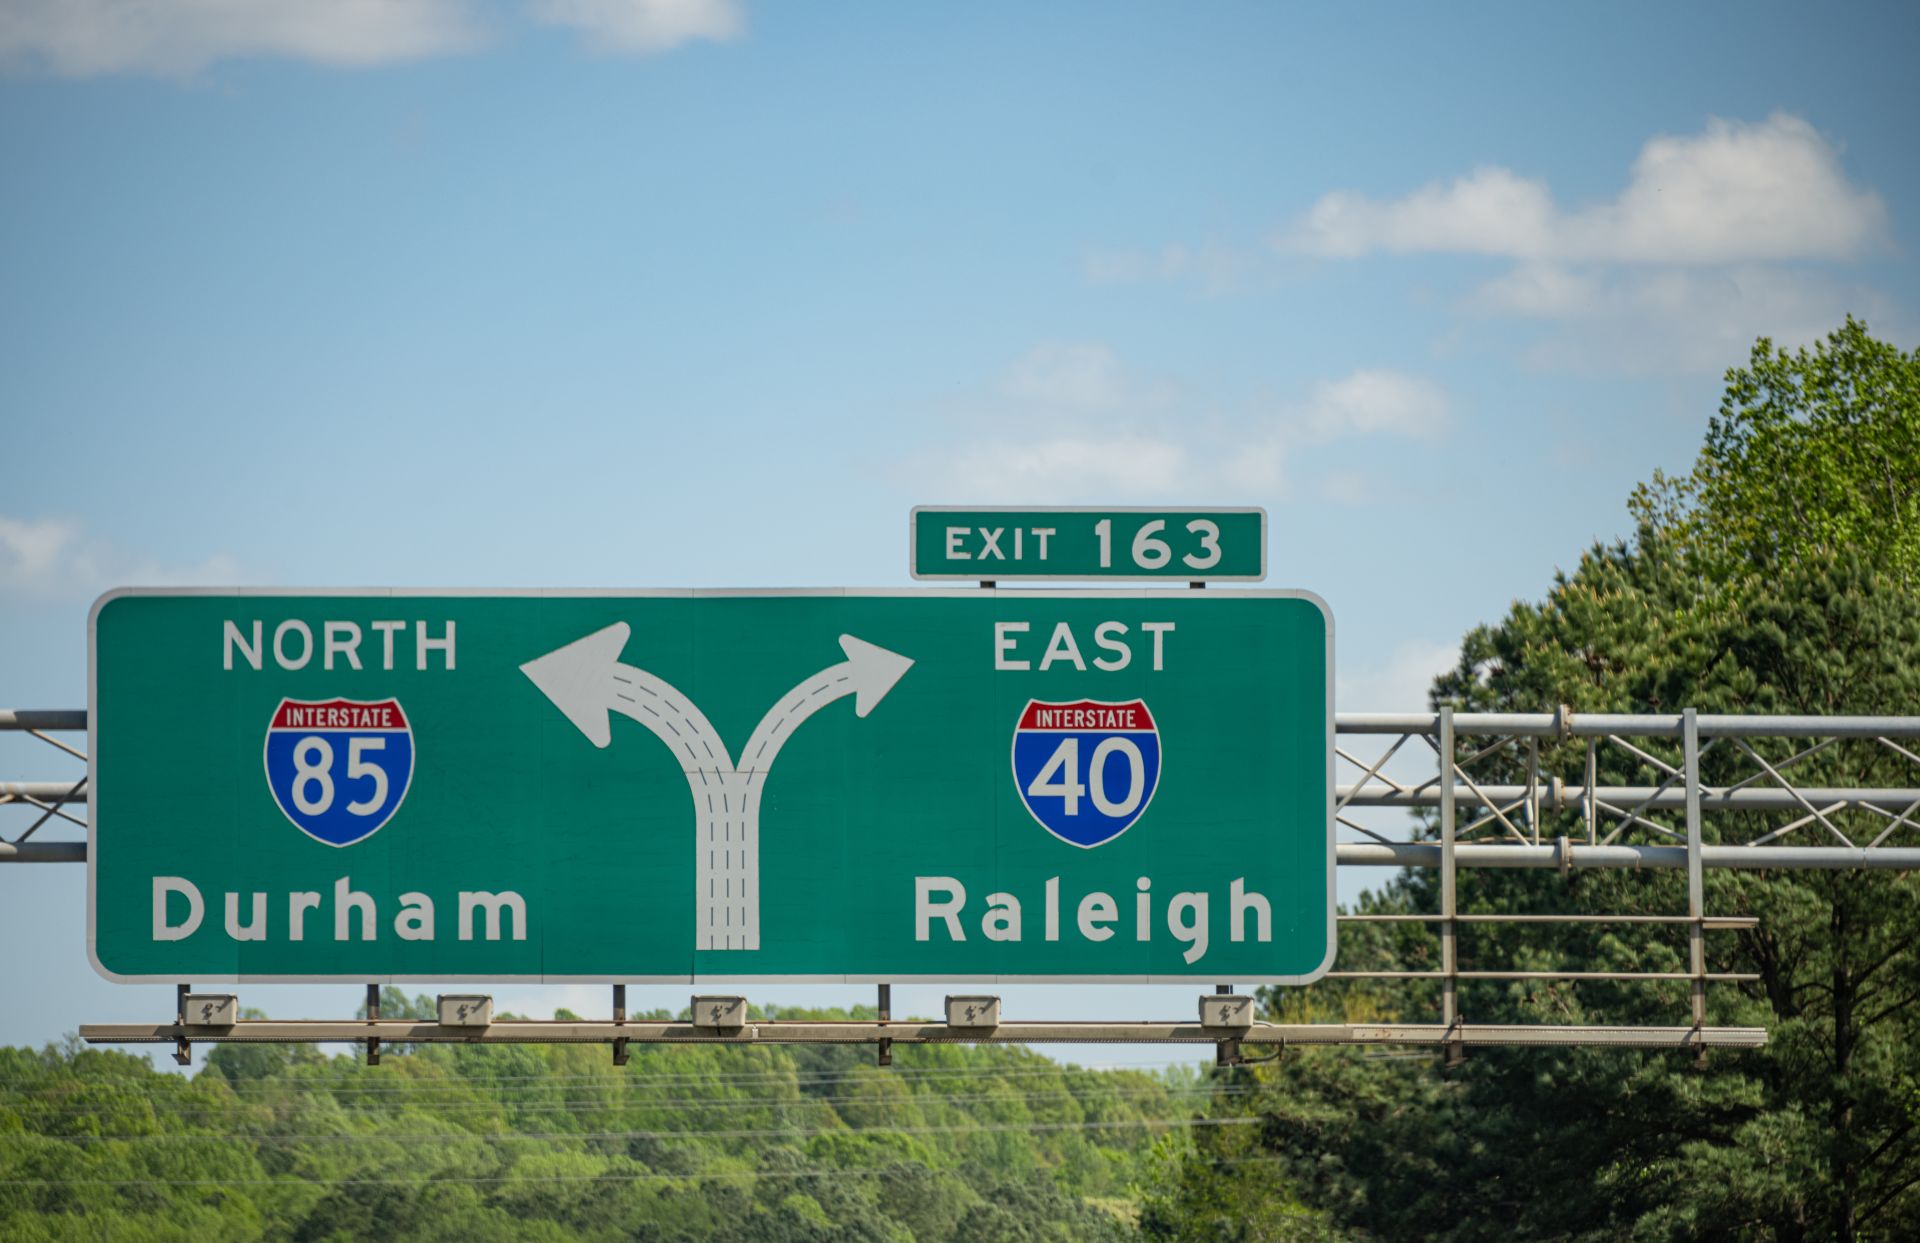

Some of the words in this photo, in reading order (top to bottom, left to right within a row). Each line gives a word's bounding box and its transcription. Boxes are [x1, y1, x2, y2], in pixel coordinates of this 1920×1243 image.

[946, 527, 1056, 560] EXIT
[1095, 519, 1222, 569] 163
[223, 619, 456, 670] NORTH
[994, 621, 1176, 672] EAST
[285, 705, 393, 728] INTERSTATE
[1035, 707, 1136, 729] INTERSTATE
[291, 736, 388, 816] 85
[1027, 736, 1145, 818] 40
[152, 876, 527, 941] Durham
[915, 876, 1272, 964] Raleigh
